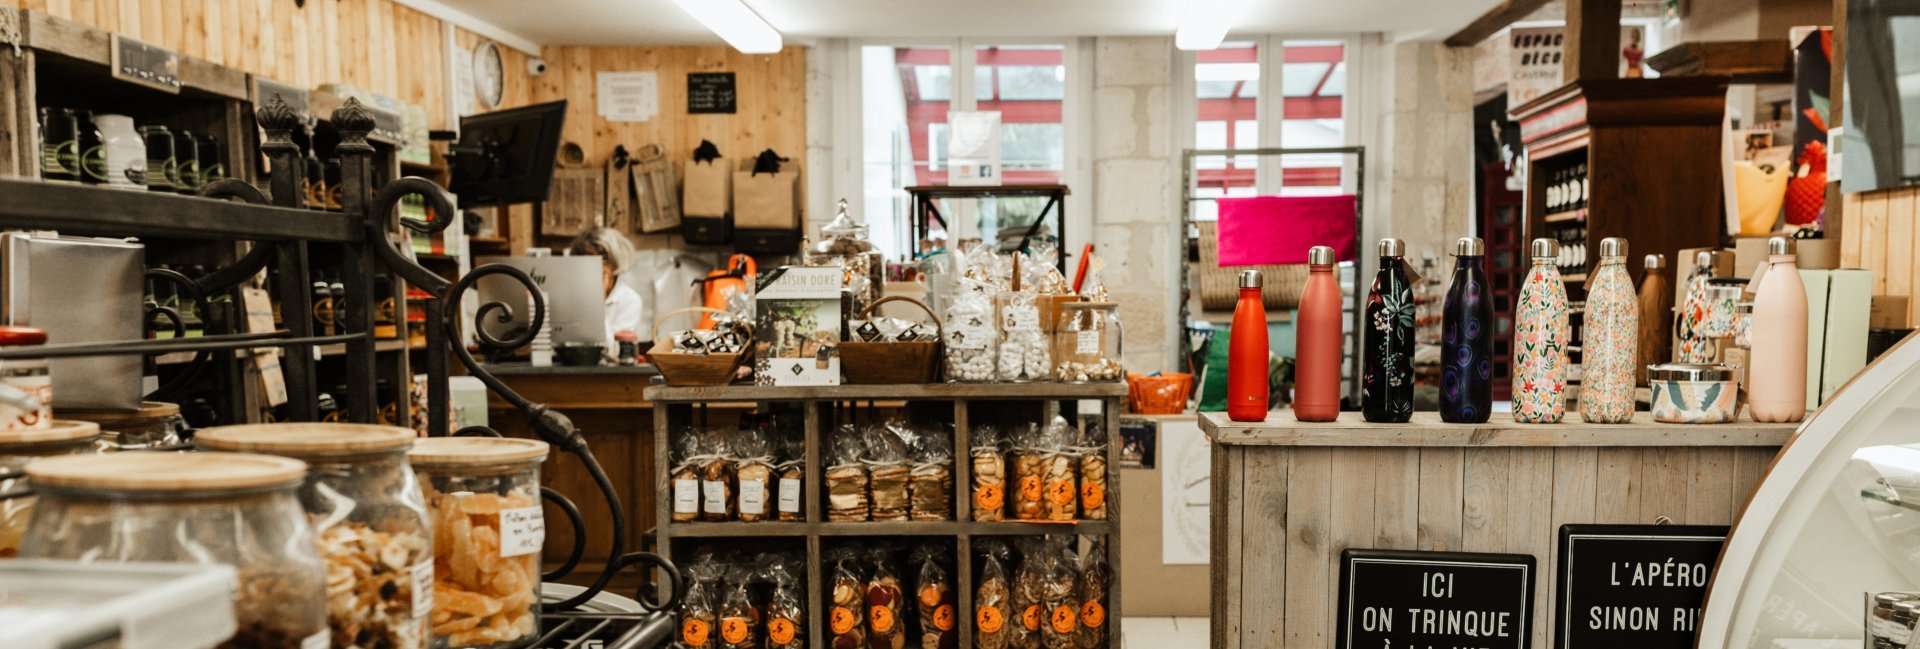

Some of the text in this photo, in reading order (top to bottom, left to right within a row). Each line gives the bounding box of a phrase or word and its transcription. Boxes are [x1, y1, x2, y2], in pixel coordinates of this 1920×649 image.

[1513, 33, 1563, 48] ESPAC
[1422, 572, 1454, 598] ICI
[1611, 557, 1707, 587] L'APÉRO
[1362, 606, 1510, 637] ON TRINQUE
[1589, 605, 1701, 632] SINON RI
